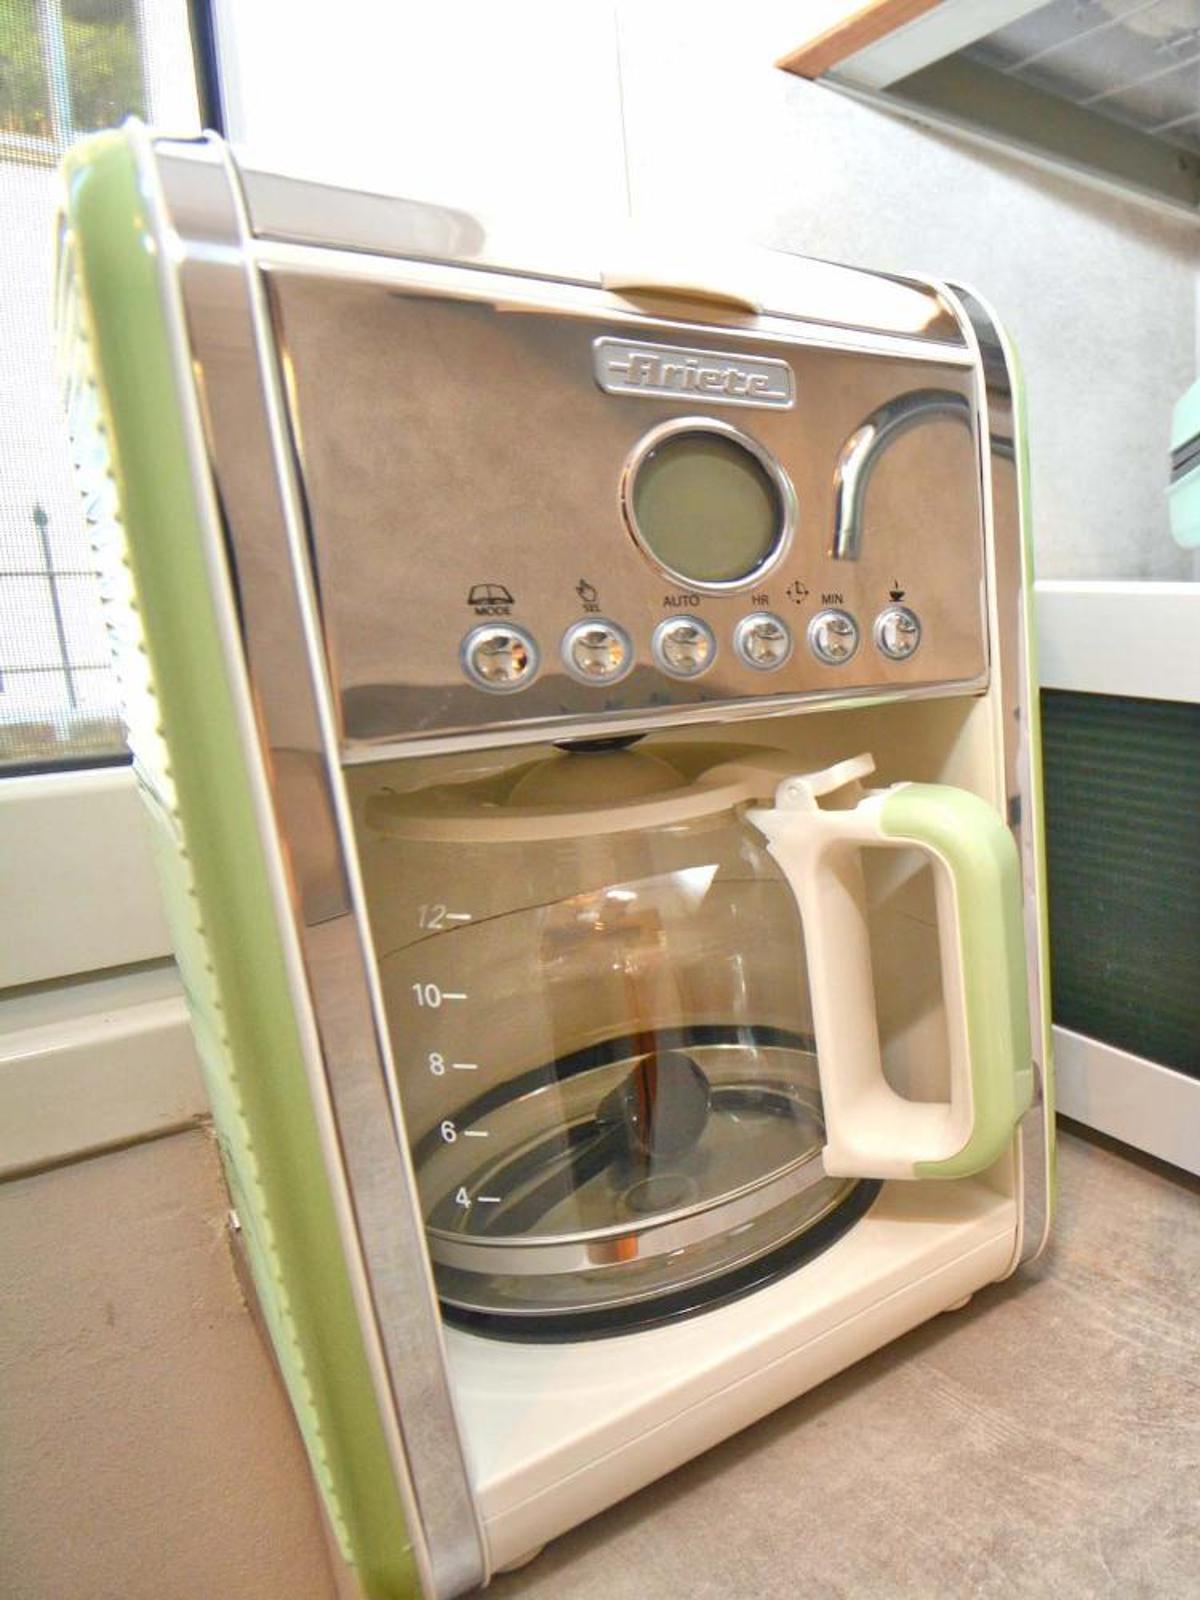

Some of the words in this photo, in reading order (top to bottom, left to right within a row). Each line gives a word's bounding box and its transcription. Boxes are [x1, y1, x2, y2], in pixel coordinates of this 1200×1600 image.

[608, 352, 787, 396] Ariete
[663, 594, 700, 607] AUTO
[752, 594, 770, 606] HR
[822, 592, 845, 605] MIN
[474, 605, 512, 616] MODE
[417, 904, 446, 929] 12
[412, 982, 442, 1007] 10
[429, 1052, 446, 1077] 8
[440, 1120, 457, 1143] 6
[455, 1187, 472, 1209] 4
